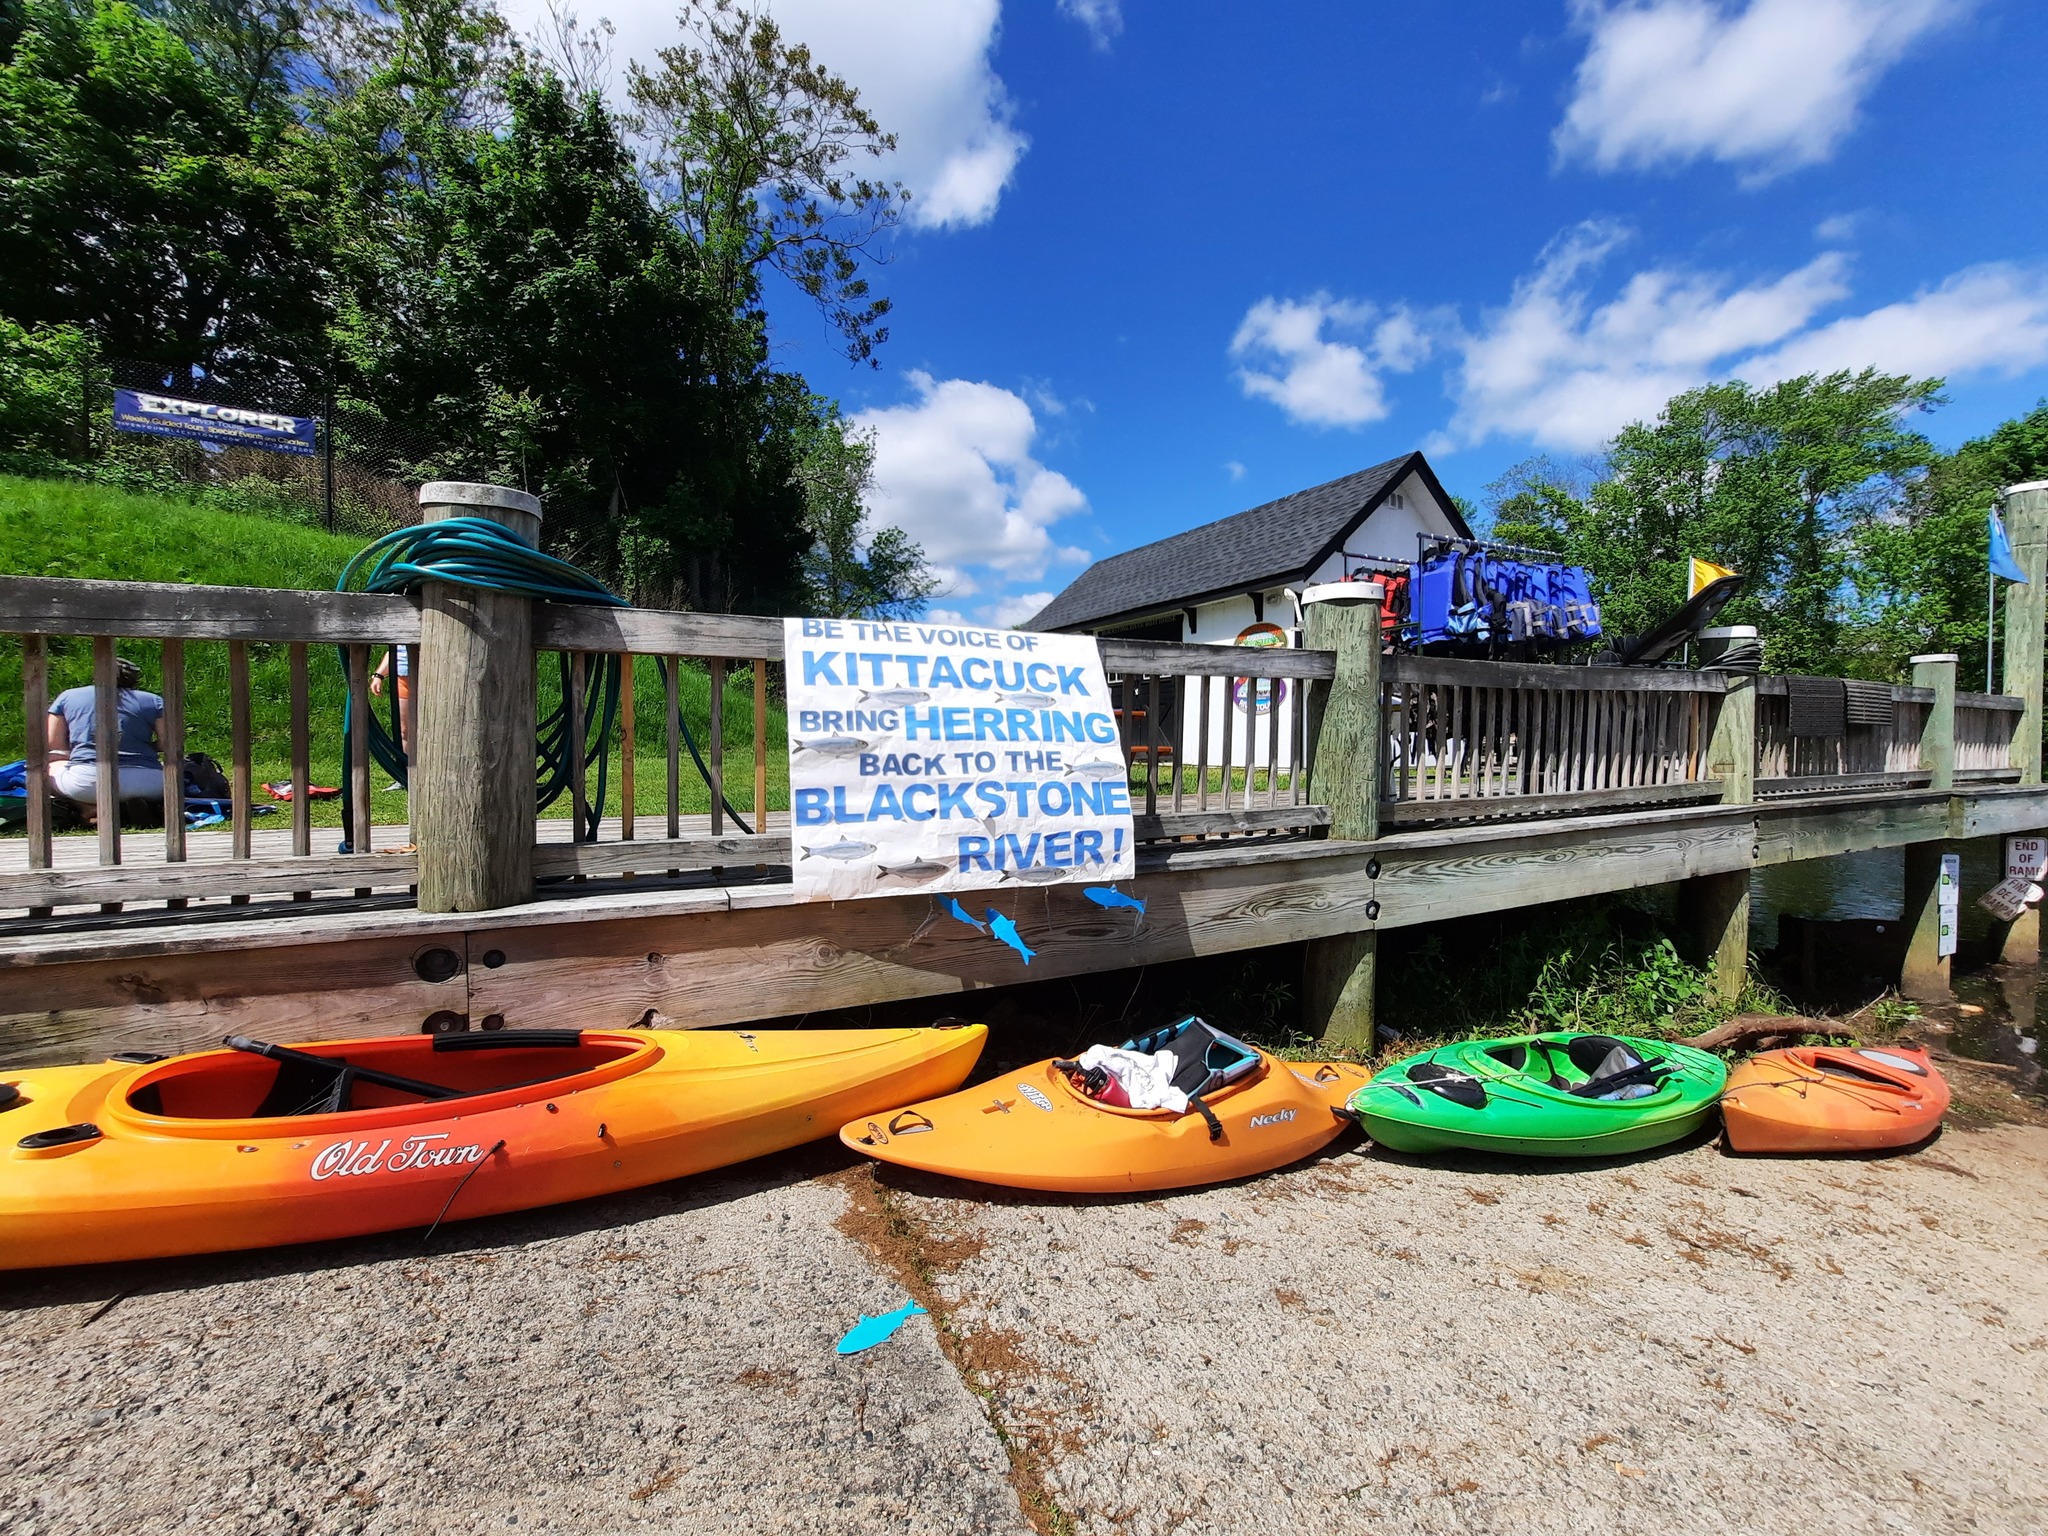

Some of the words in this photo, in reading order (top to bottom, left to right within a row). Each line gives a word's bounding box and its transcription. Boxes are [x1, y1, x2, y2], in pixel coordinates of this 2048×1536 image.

[138, 393, 296, 434] EXPLORER
[152, 417, 182, 428] Guided
[802, 619, 844, 639] BE
[849, 623, 912, 643] THE
[917, 627, 1001, 650] VOICE
[1006, 634, 1039, 652] OF
[802, 651, 1091, 697] KITTACUCK
[800, 710, 900, 732] BRING
[905, 706, 1116, 743] HERRING
[859, 753, 946, 776] BACK
[951, 752, 996, 774] TO
[1005, 751, 1064, 773] THE
[795, 781, 1130, 826] BLACKSTONE
[957, 828, 1124, 874] RIVER!
[2015, 841, 2038, 851] END
[2018, 853, 2033, 863] OF
[2009, 866, 2043, 876] RAMP
[1997, 887, 2012, 899] DE
[1249, 1107, 1297, 1129] Necky
[310, 1139, 392, 1181] Old
[387, 1132, 484, 1172] Town
